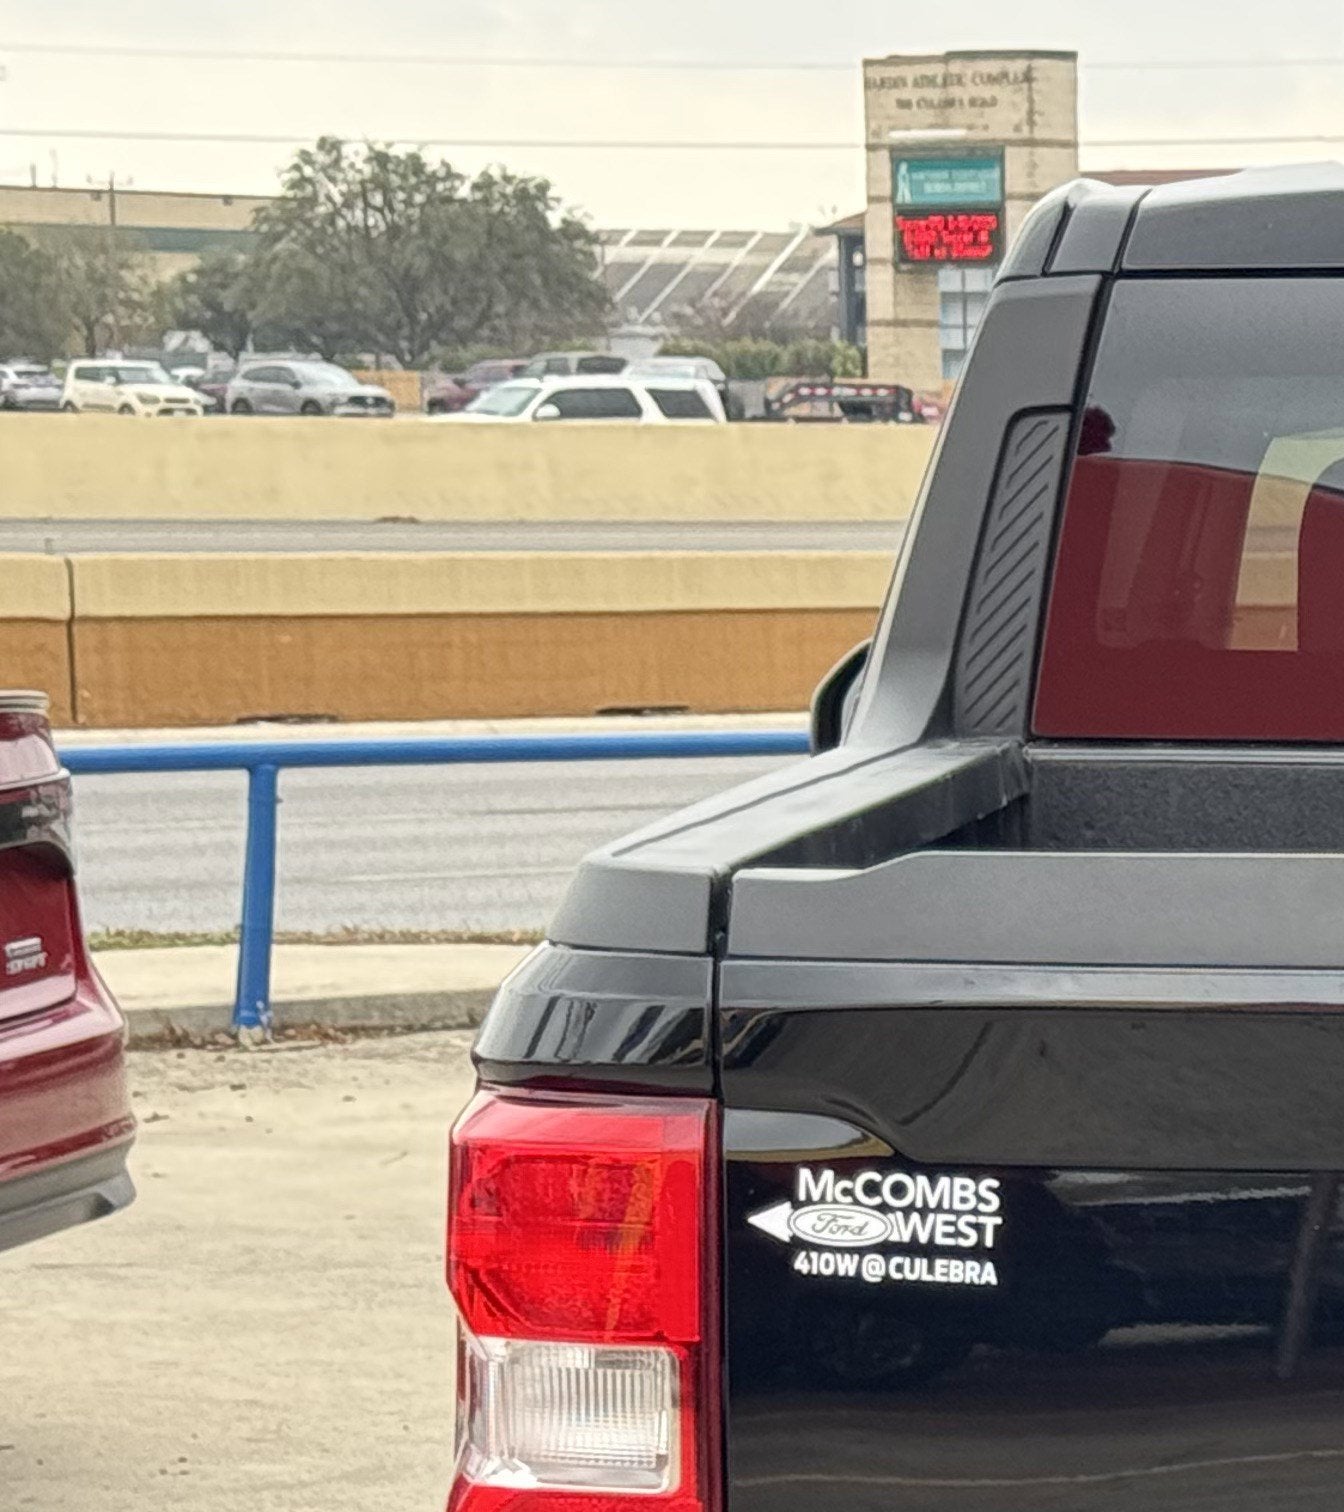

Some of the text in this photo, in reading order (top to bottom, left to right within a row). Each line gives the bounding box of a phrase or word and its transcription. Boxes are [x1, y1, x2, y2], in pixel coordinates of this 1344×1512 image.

[798, 1168, 1000, 1212] McCOMBS
[812, 1212, 1003, 1247] Ford WEST
